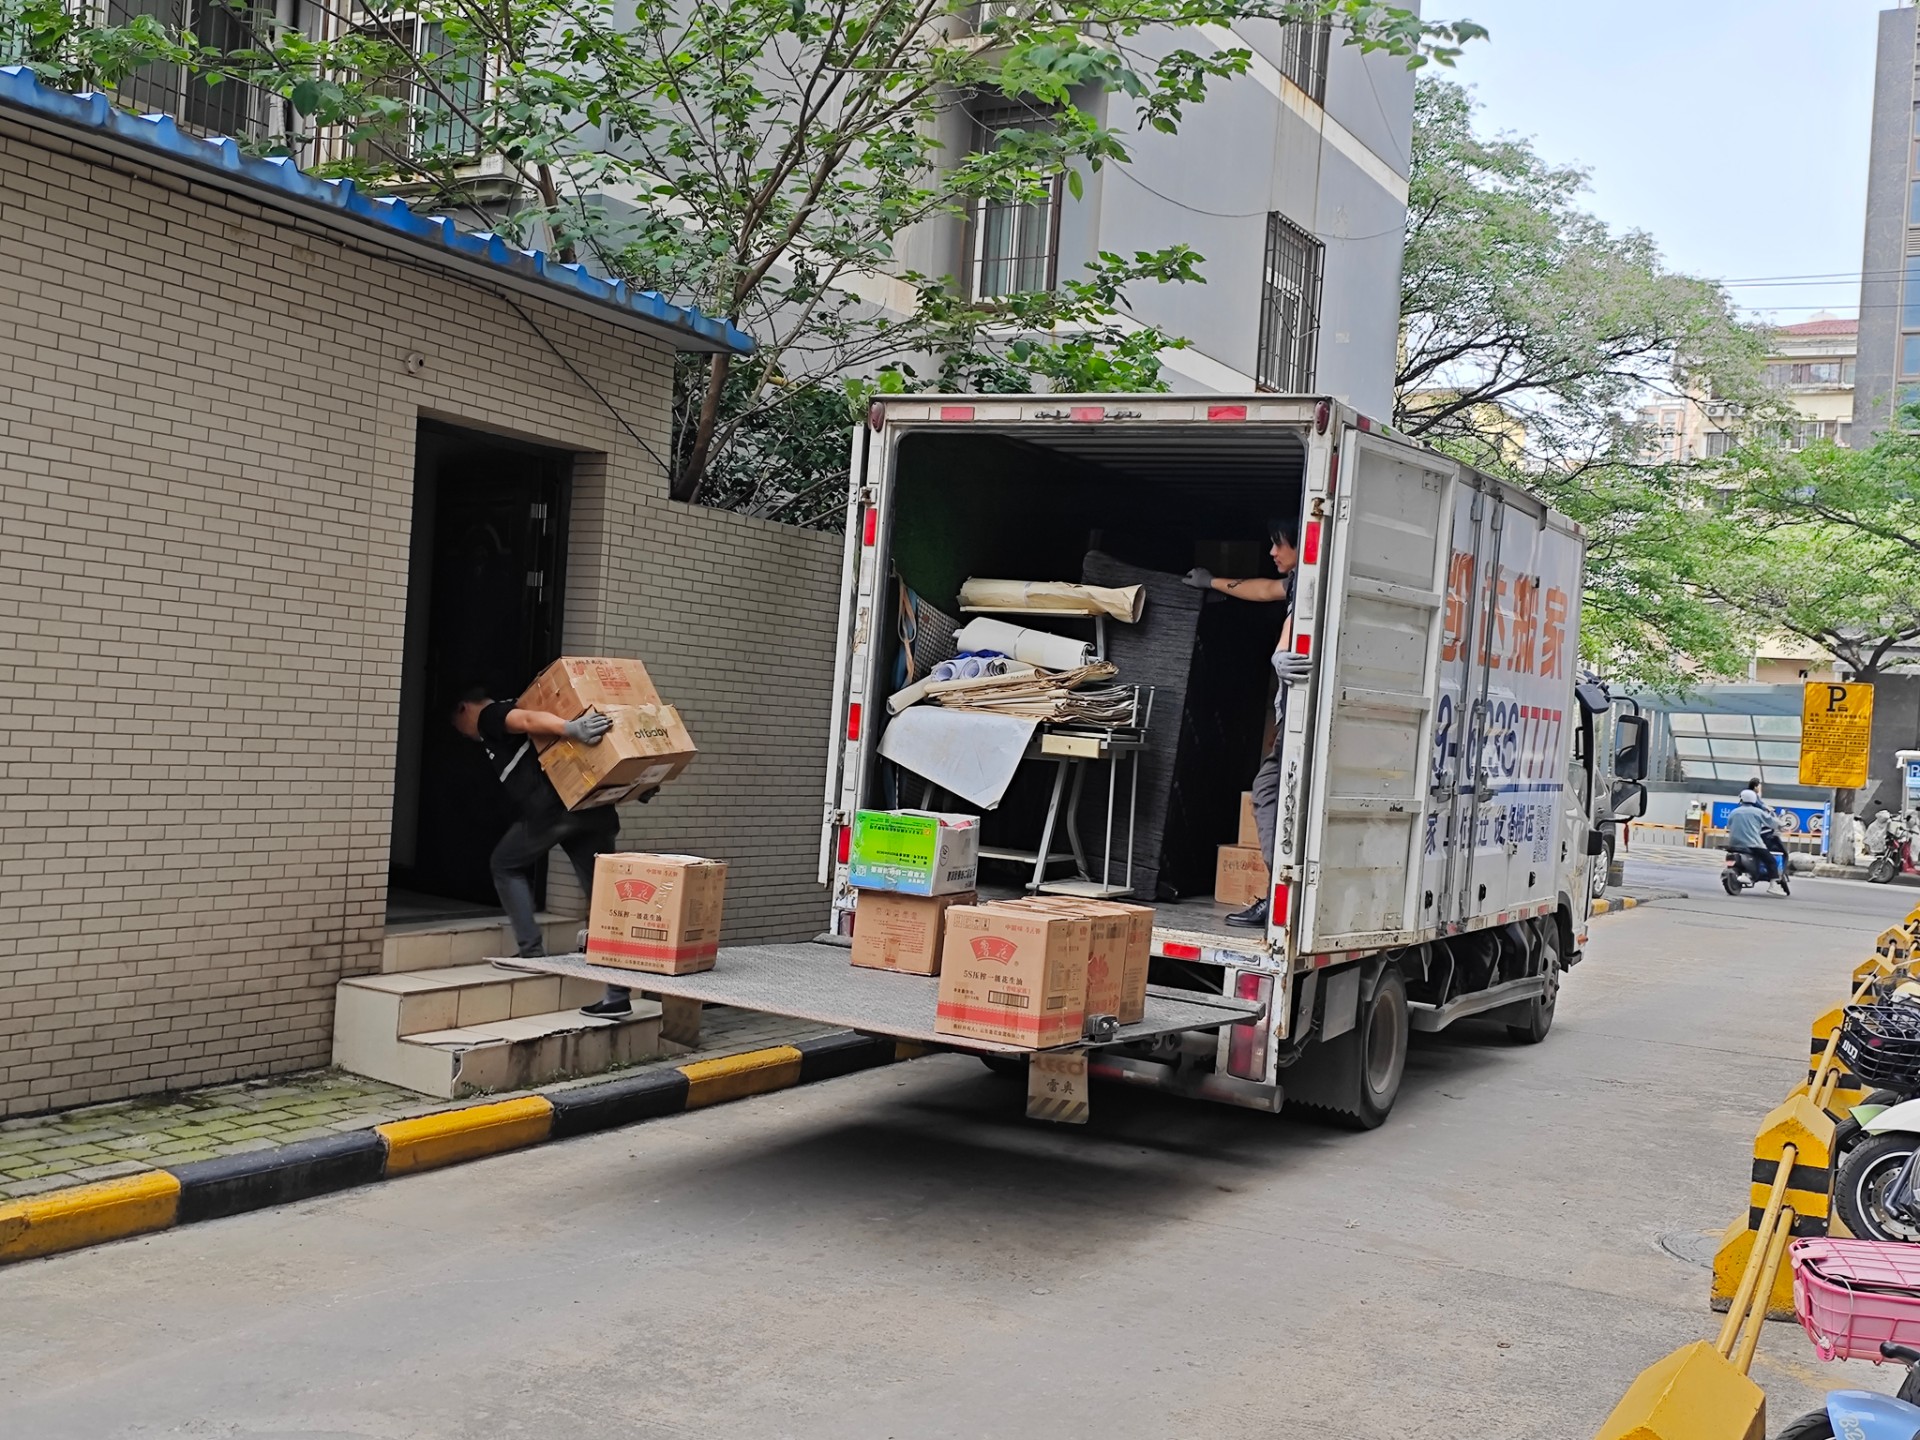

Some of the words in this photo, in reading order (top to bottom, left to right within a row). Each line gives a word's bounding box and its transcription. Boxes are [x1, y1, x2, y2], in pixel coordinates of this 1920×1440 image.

[1826, 685, 1847, 712] P
[619, 881, 650, 900] 鲁花
[977, 939, 1009, 961] 鲁花
[963, 969, 1023, 986] 5S压榨一级花生油
[1046, 1078, 1075, 1095] 雷奥
